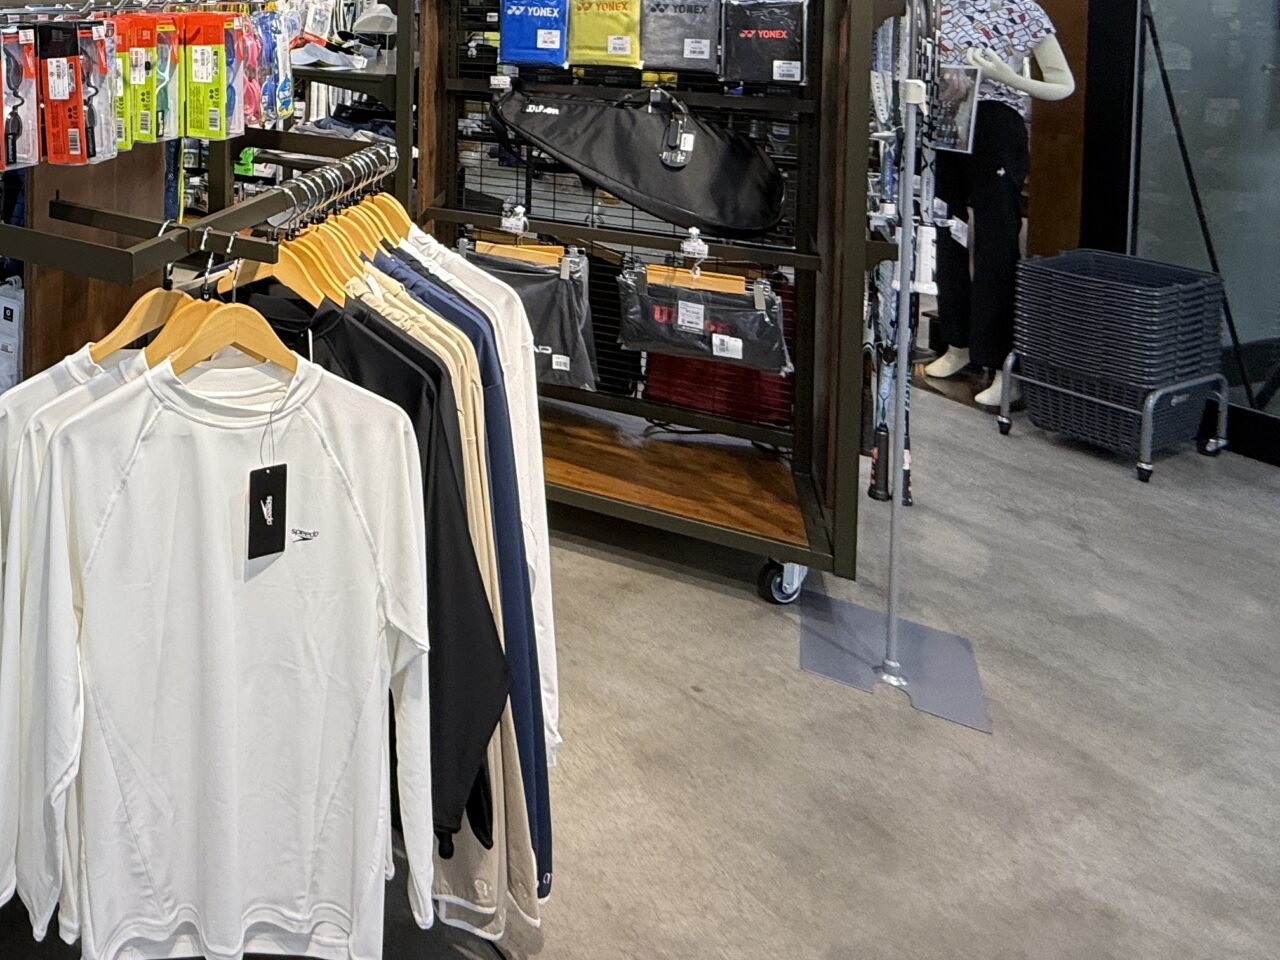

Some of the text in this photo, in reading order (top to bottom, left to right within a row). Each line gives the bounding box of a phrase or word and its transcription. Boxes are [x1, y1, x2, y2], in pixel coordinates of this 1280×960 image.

[595, 0, 629, 11] YONEX
[672, 4, 708, 14] YONEX
[527, 6, 560, 18] YONEX
[757, 29, 788, 39] YONEX
[290, 528, 320, 538] speedo
